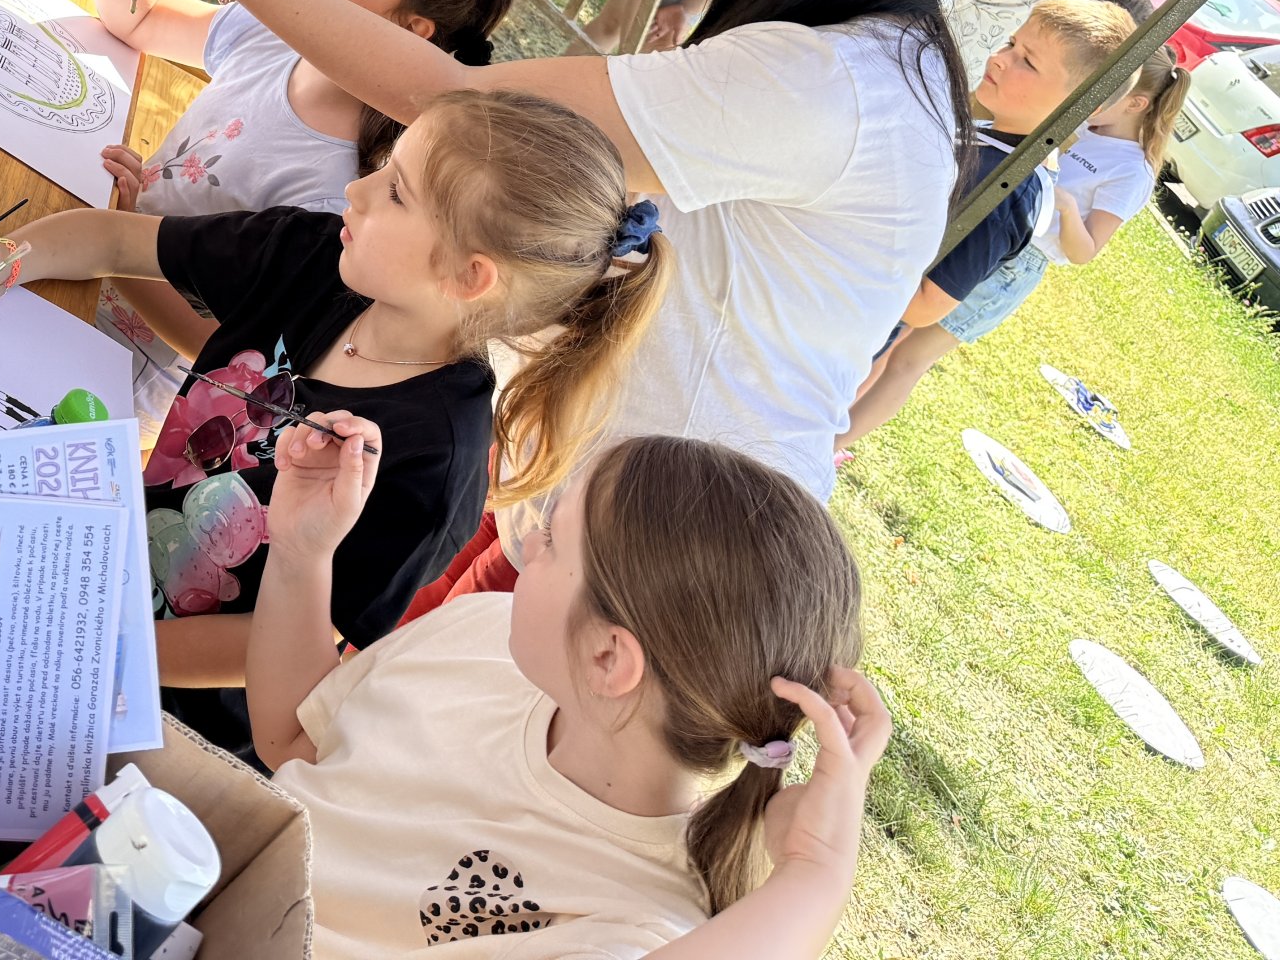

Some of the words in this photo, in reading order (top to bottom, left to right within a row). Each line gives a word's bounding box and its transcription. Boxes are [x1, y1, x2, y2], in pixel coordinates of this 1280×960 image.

[6, 463, 16, 479] 180
[18, 455, 28, 479] CENA
[33, 445, 63, 498] 202
[83, 525, 94, 546] 554
[81, 550, 92, 571] 354
[97, 524, 111, 594] Michalovciach
[78, 575, 90, 605] 0948
[70, 608, 88, 690] 056-6421932,
[90, 606, 104, 664] Zvonického
[86, 667, 98, 710] Gorazda
[83, 712, 94, 754] knižnica
[66, 743, 75, 770] ďalšie
[62, 779, 72, 812] Kontakt
